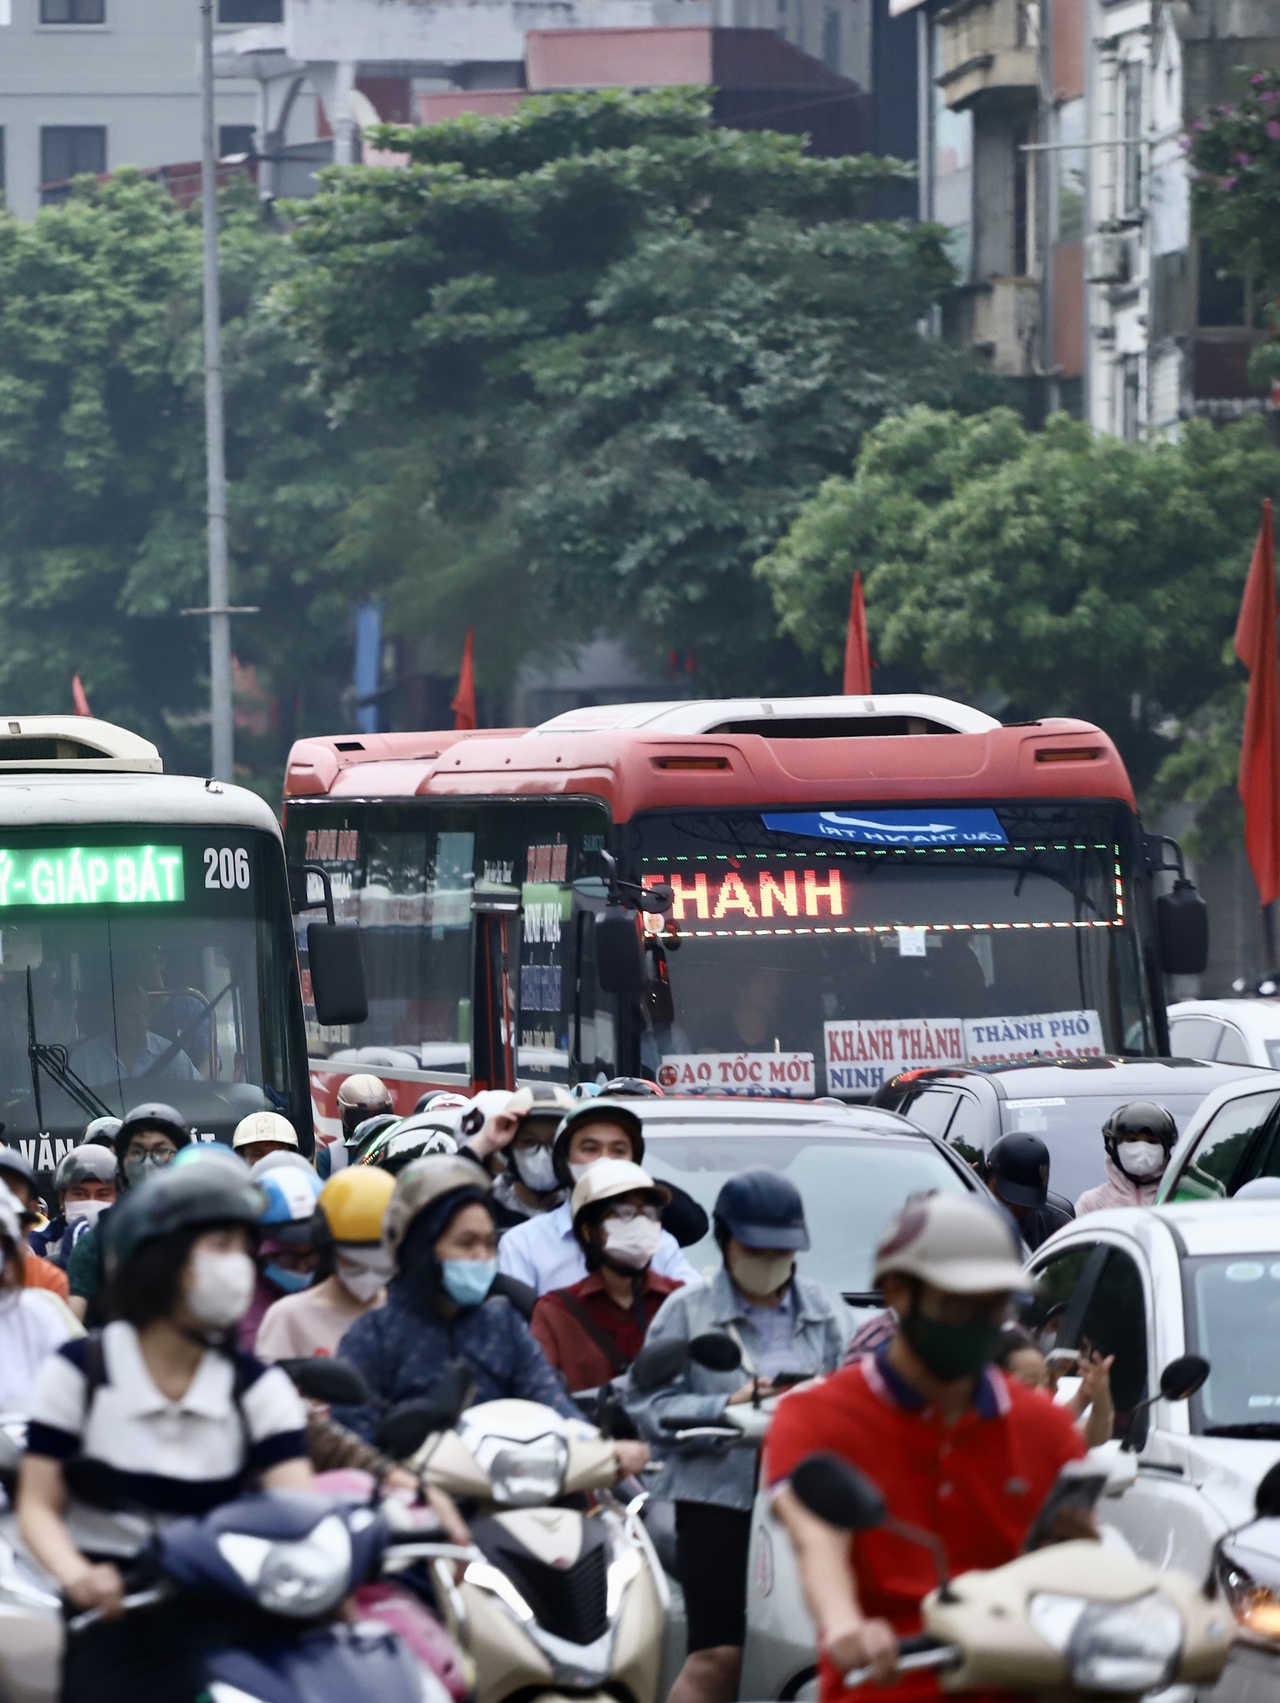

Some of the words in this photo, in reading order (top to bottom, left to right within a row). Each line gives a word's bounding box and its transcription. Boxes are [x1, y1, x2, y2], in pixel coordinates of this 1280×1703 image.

[121, 845, 180, 902] BÁT
[203, 847, 250, 889] 206
[827, 1020, 895, 1062] KHÁNH
[898, 1019, 962, 1060] THÀNH
[972, 1019, 1045, 1043] THÀNH
[1048, 1009, 1090, 1038] PHỐ
[673, 1062, 712, 1084] AO
[718, 1052, 763, 1083] TỐC
[768, 1054, 811, 1083] MỚI
[829, 1066, 884, 1089] NINH
